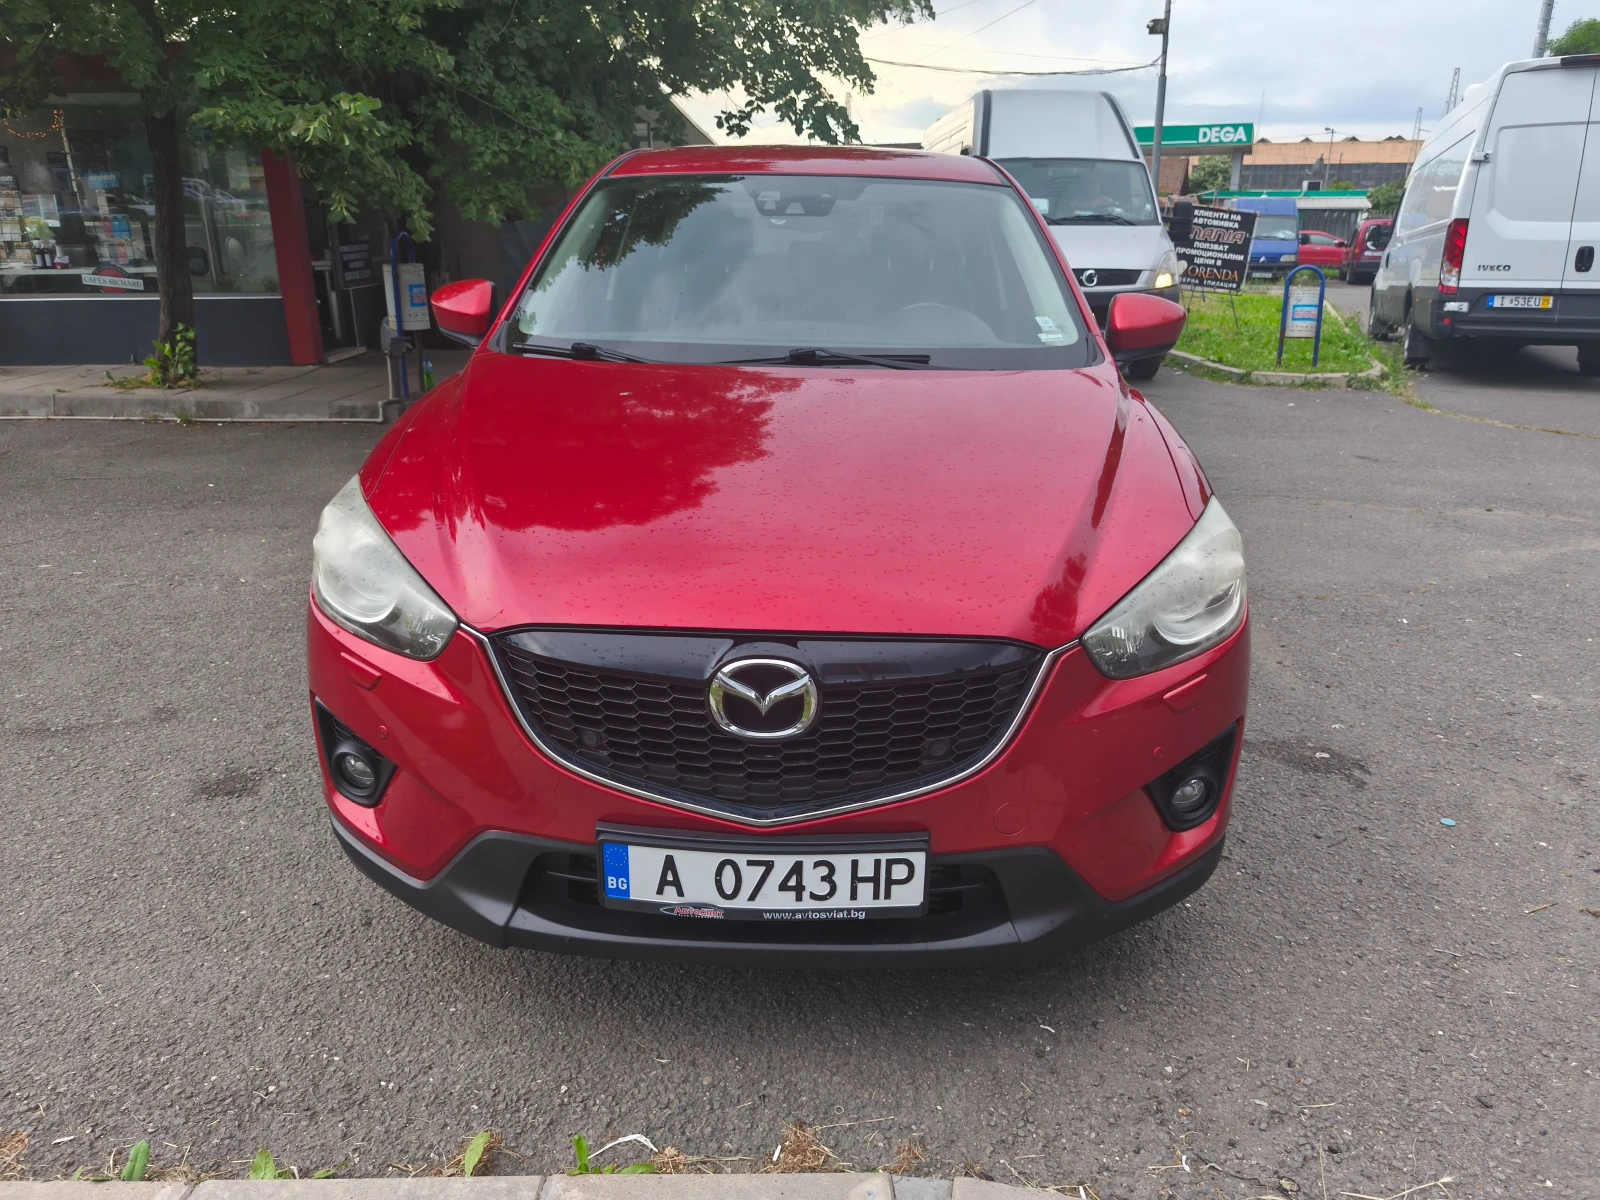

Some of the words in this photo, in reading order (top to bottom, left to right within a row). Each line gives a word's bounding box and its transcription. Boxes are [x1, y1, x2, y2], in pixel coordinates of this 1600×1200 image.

[1198, 126, 1247, 143] DEGA
[1194, 209, 1229, 219] КЛИЕНТИ
[1230, 213, 1241, 221] НА
[1193, 217, 1239, 229] АВТОМИВКА
[1176, 247, 1244, 261] ПРОМОЦИОНАЛНИ
[1194, 257, 1215, 265] ЦЕНИ
[1187, 265, 1239, 281] ORENDA
[108, 278, 142, 288] RICHARD
[1203, 279, 1237, 288] ЕПИЛАЦИЯ
[607, 876, 628, 890] BG
[655, 854, 685, 897] A
[714, 858, 838, 902] 0743
[849, 857, 916, 901] HP
[762, 909, 866, 920] www.avtosviat.bg
